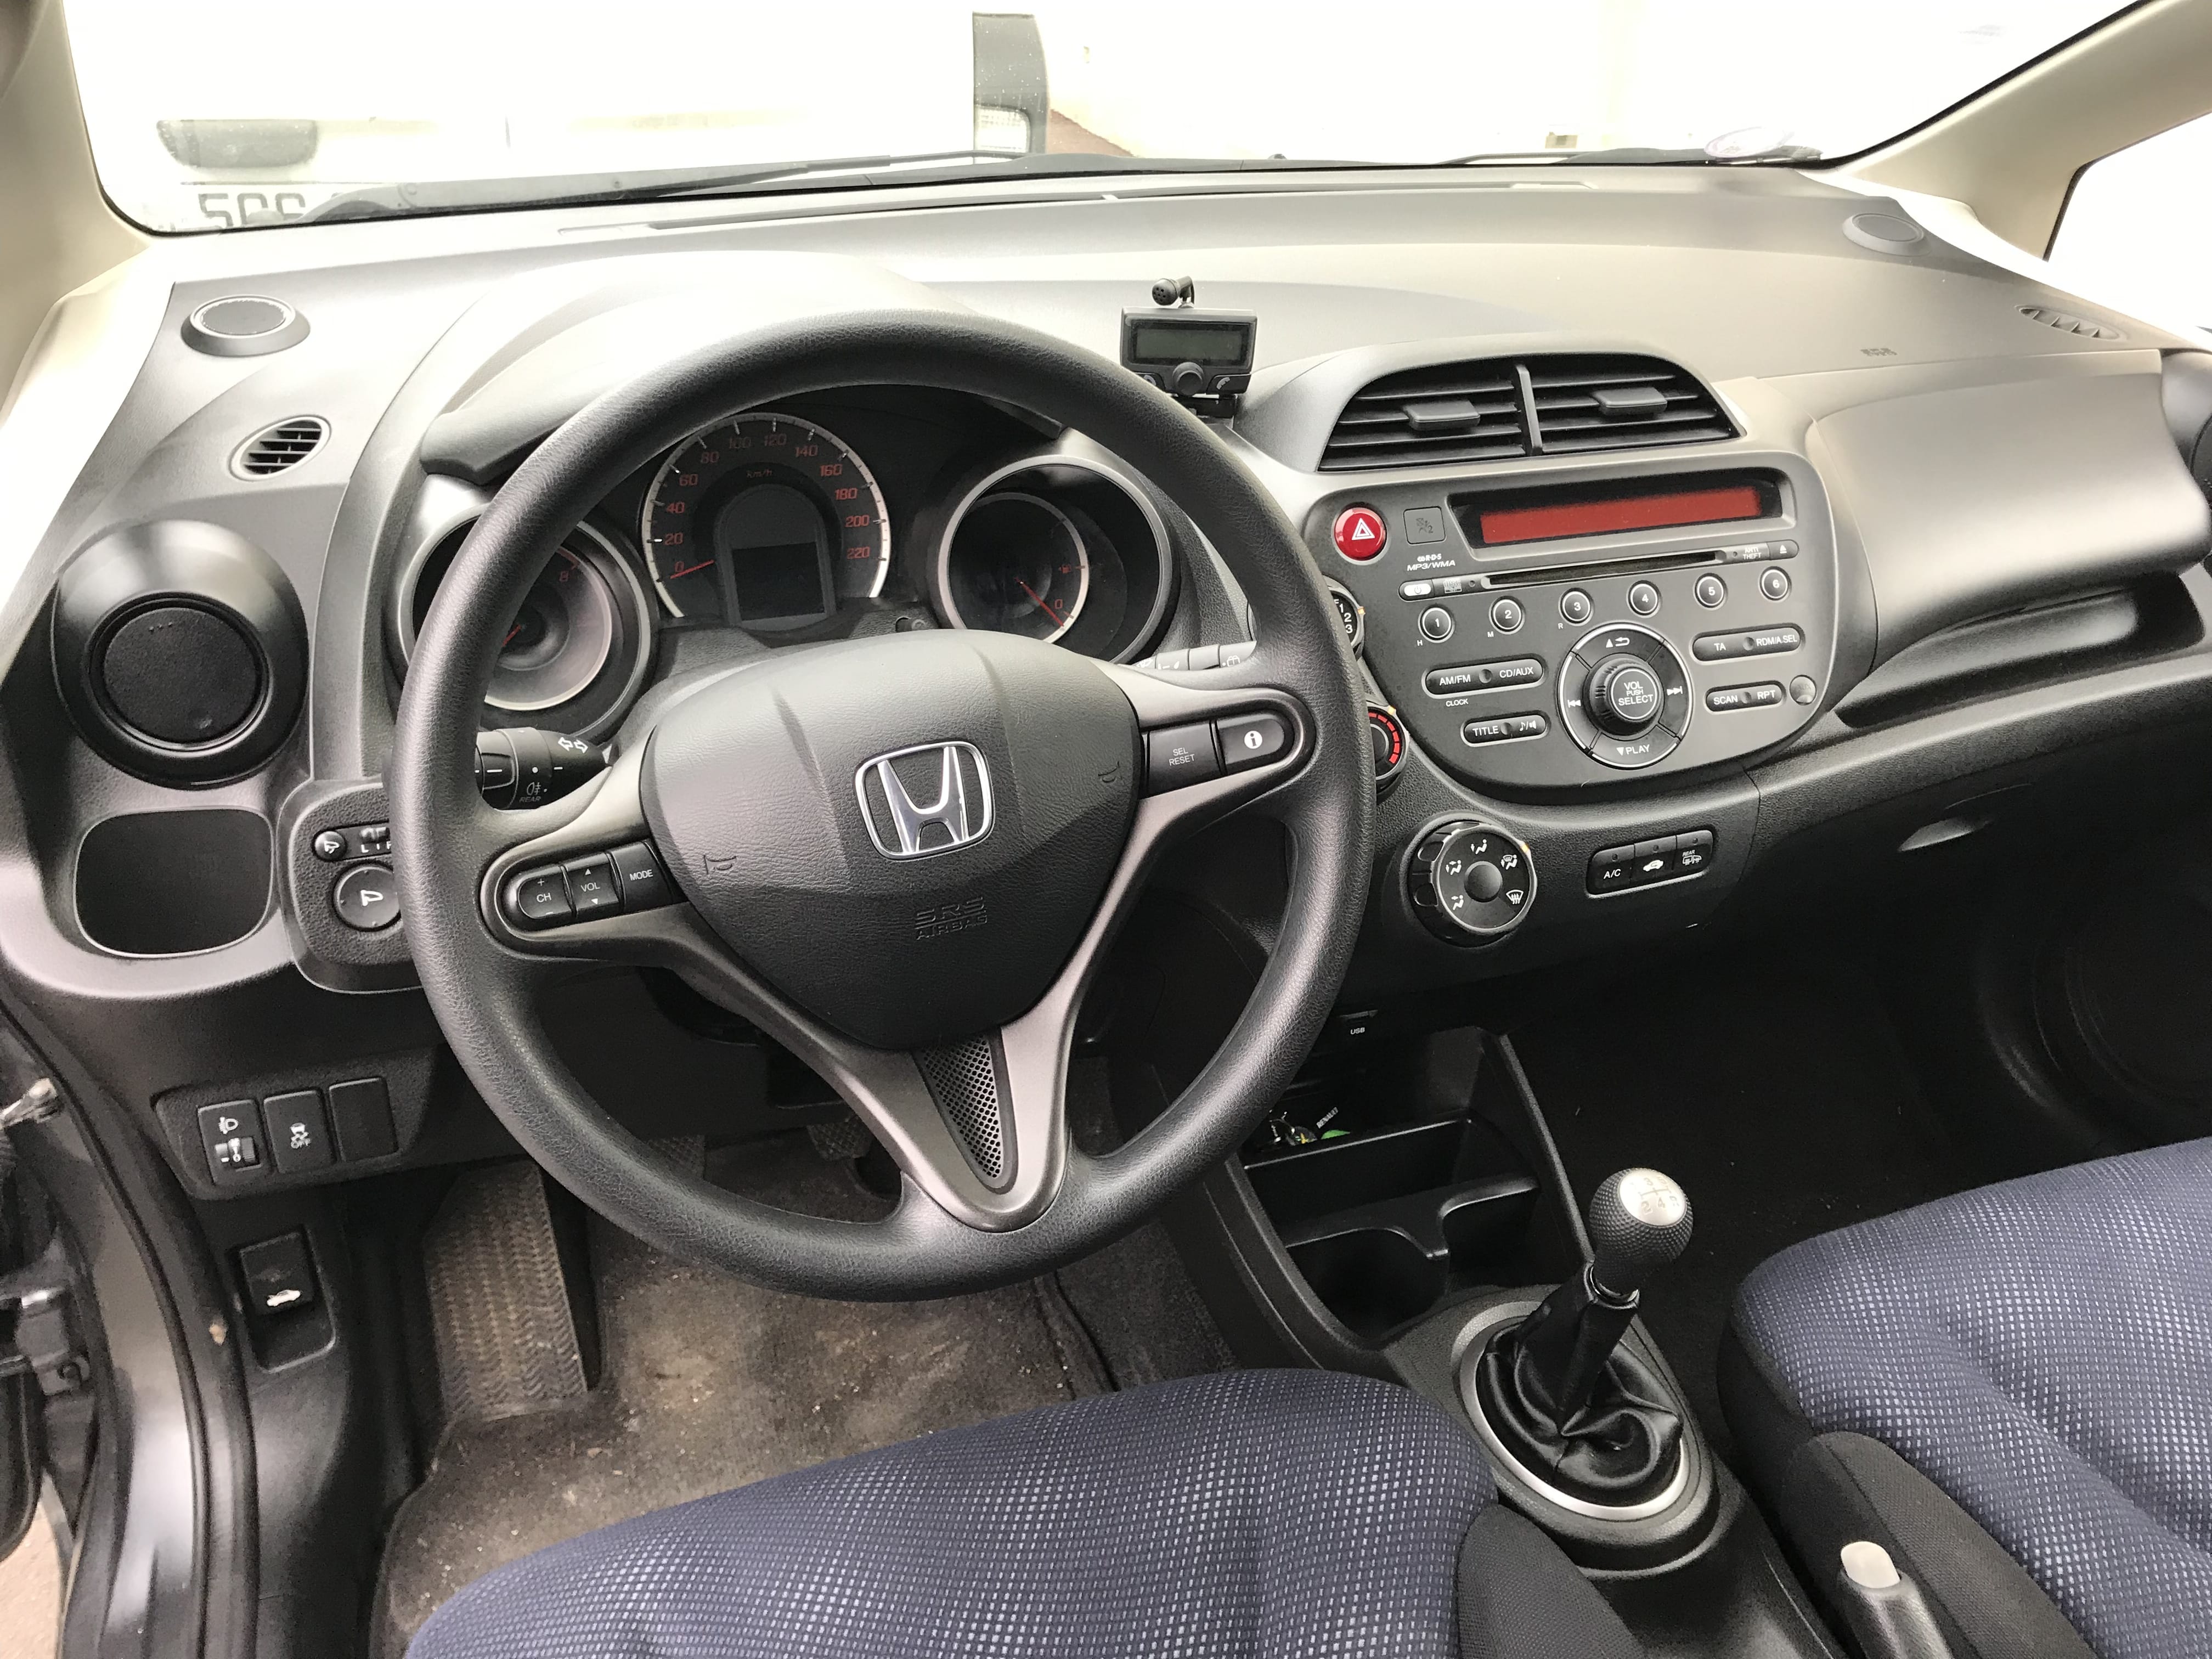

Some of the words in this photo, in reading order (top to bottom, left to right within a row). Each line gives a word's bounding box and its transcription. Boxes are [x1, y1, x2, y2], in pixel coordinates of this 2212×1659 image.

[729, 437, 751, 449] 100
[764, 433, 787, 446] 120
[795, 445, 818, 456] 140
[701, 451, 719, 463] 80
[820, 464, 843, 476] 160
[679, 474, 698, 486] 60
[835, 488, 857, 500] 180
[667, 502, 685, 514] 40
[845, 515, 869, 527] 200
[664, 533, 683, 545] 20
[847, 547, 870, 559] 220
[674, 561, 684, 572] 0
[1407, 560, 1455, 572] MP3/WMA
[1773, 579, 1780, 589] 6
[1708, 587, 1716, 596] 5
[1641, 594, 1649, 603] 4
[1339, 603, 1344, 613] 1
[1574, 602, 1581, 612] 3
[1344, 612, 1352, 622] 2
[1504, 610, 1513, 619] 2
[1435, 618, 1440, 628] 1
[1345, 624, 1353, 634] 3
[1714, 642, 1726, 652] TA
[1499, 666, 1534, 679] CD/AUX
[1439, 674, 1471, 686] AM/FM
[1623, 681, 1643, 692] VOL
[1618, 695, 1654, 706] SELECT
[1713, 695, 1738, 706] SCAN
[1757, 690, 1776, 701] RPT
[1446, 698, 1469, 707] CLOCK
[1472, 725, 1499, 737] TITLE
[1172, 747, 1189, 757] SEL
[1626, 744, 1650, 755] PLAY
[1169, 753, 1195, 767] RESET
[519, 795, 541, 804] REAR
[361, 844, 369, 853] L
[629, 869, 653, 882] MODE
[1604, 868, 1621, 879] A/C
[581, 882, 600, 892] VOL
[536, 893, 552, 904] CH
[915, 896, 985, 927] SRS
[916, 914, 988, 940] AIRBAG
[1350, 1027, 1365, 1035] USB
